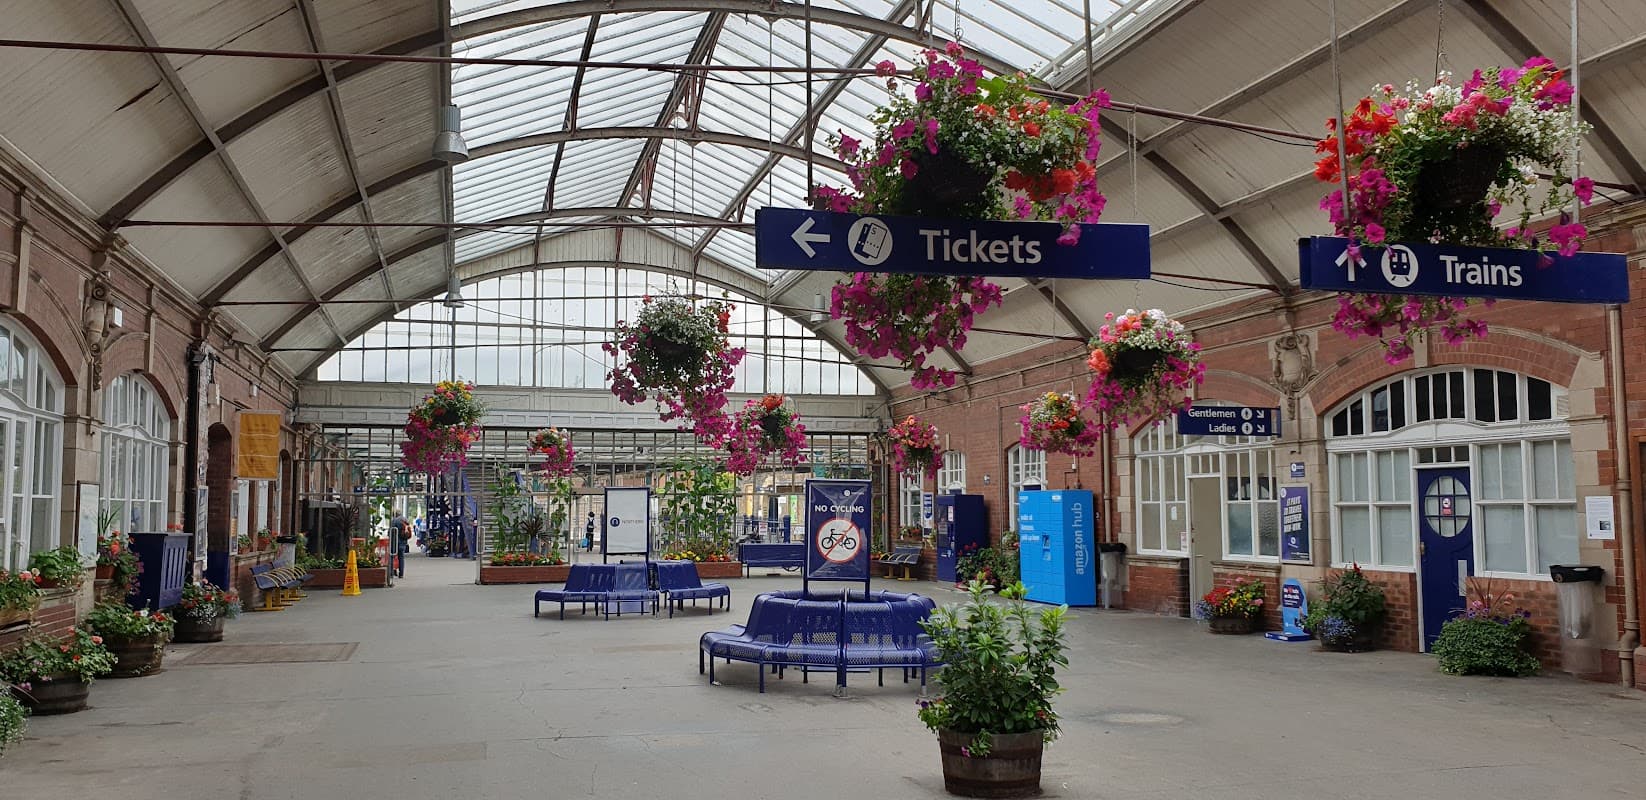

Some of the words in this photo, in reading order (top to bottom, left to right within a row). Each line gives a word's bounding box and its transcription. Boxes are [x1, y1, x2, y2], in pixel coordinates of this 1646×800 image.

[919, 229, 1042, 264] Tickets
[1439, 255, 1523, 286] Trains
[1187, 408, 1236, 418] Gentlemen
[1208, 423, 1236, 433] Ladies
[814, 504, 828, 513] NO
[829, 504, 865, 513] CYCLING
[1071, 502, 1083, 527] hub
[1074, 530, 1085, 575] amazon
